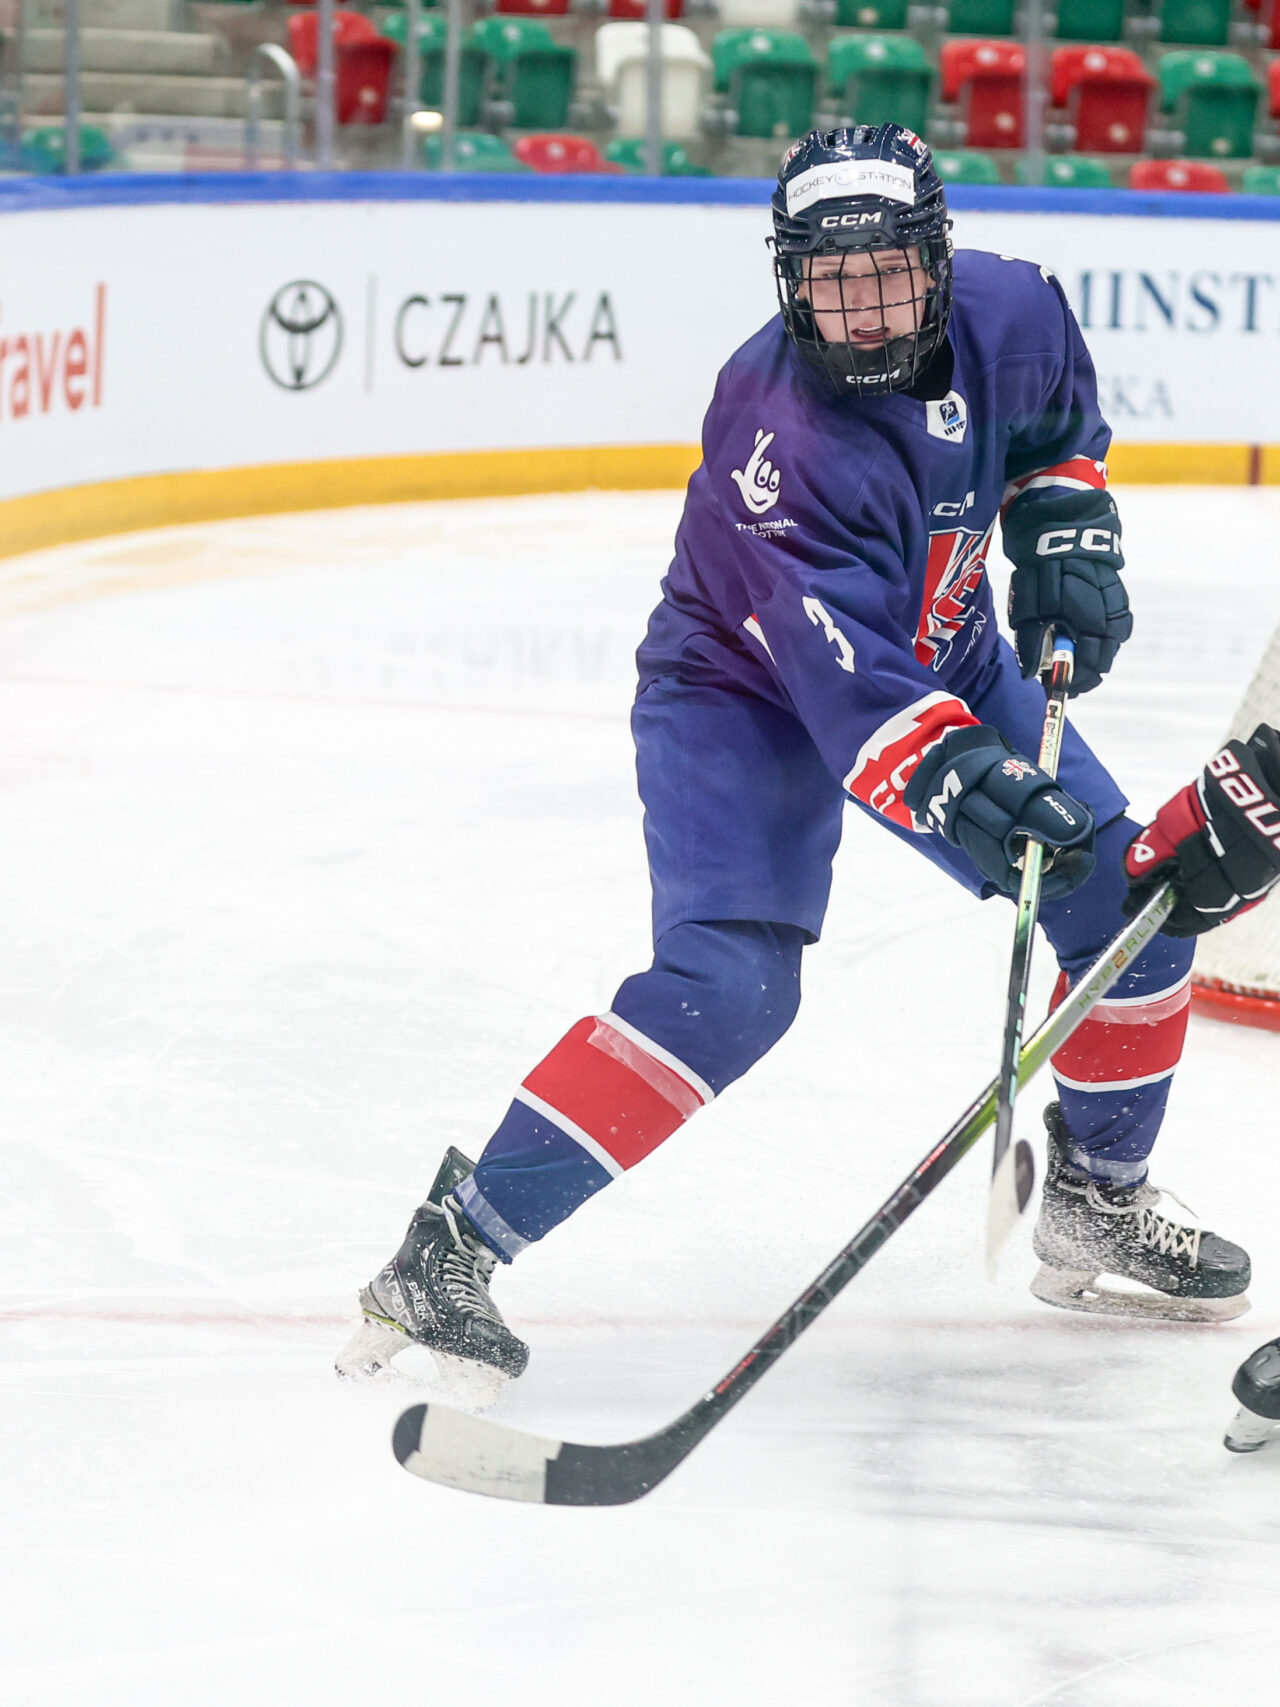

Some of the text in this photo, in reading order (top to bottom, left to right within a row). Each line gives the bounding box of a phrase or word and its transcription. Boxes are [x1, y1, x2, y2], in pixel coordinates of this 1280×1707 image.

[788, 171, 912, 202] HOCKEY STATION
[821, 211, 883, 228] CCM
[395, 289, 624, 369] CZAJKA
[0, 281, 107, 421] ravel
[846, 368, 900, 385] CCM
[758, 518, 799, 531] NTIONAL
[801, 595, 856, 674] 3
[1042, 795, 1076, 827] CCM
[1078, 896, 1169, 1009] HYP2RLIT
